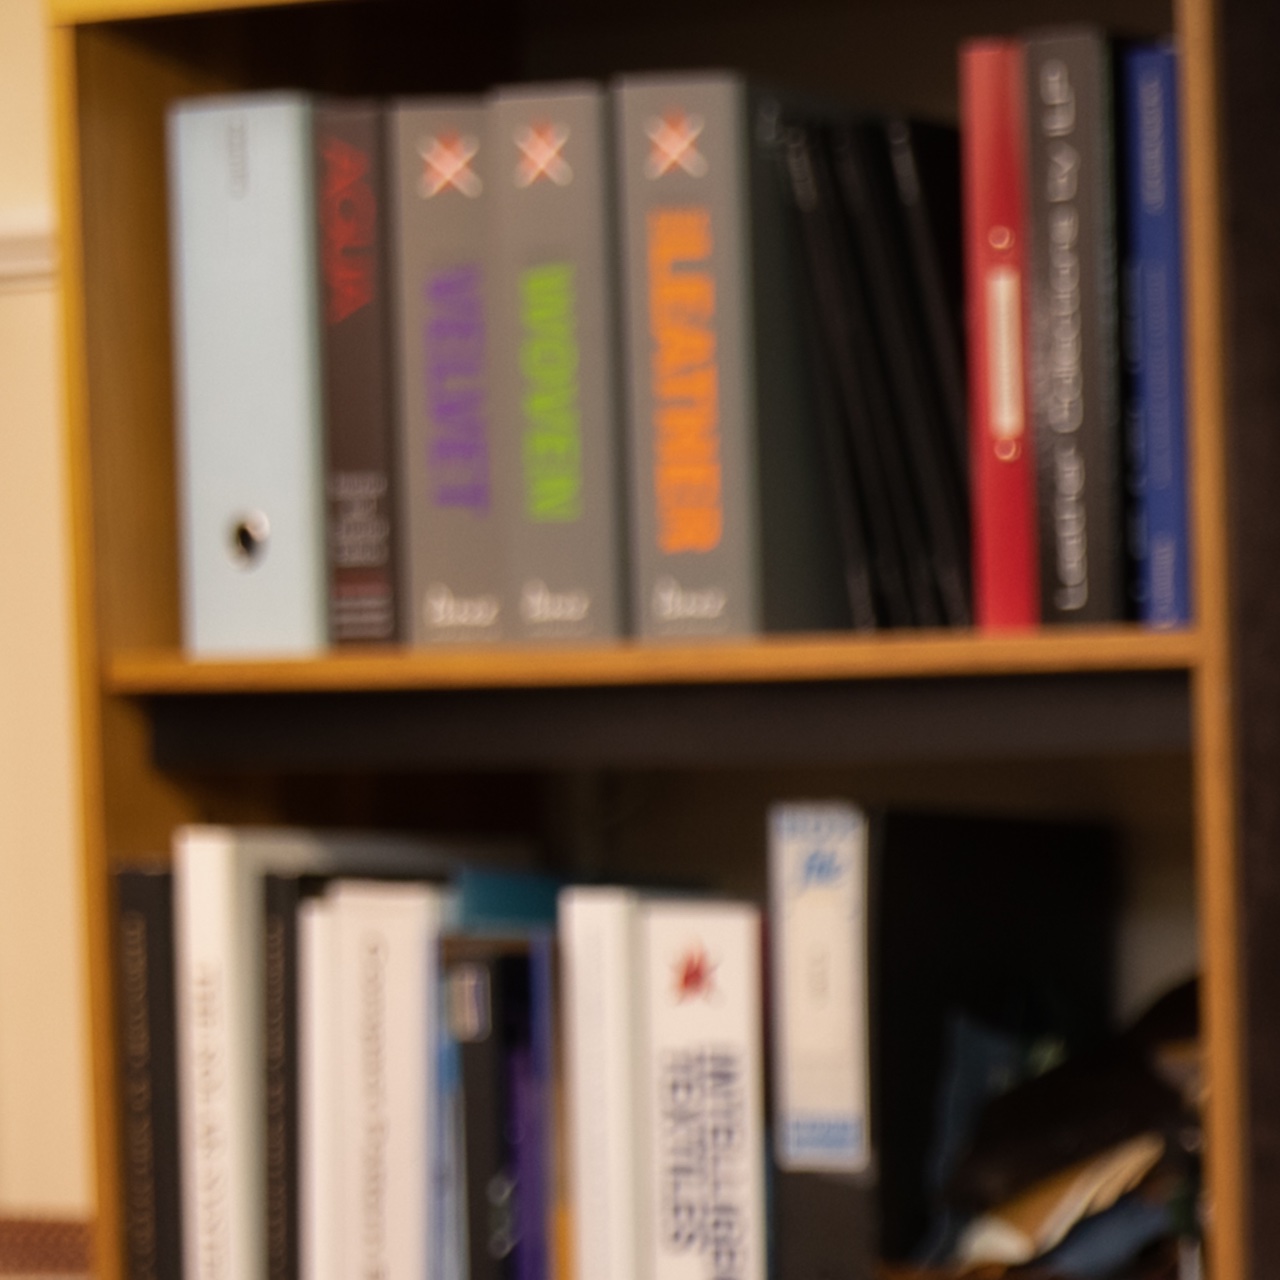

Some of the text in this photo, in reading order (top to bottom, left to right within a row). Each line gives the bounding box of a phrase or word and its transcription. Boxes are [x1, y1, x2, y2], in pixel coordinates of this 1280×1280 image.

[422, 263, 491, 517] VELVET
[519, 261, 581, 522] WOVEN
[647, 207, 723, 554] LEATHER
